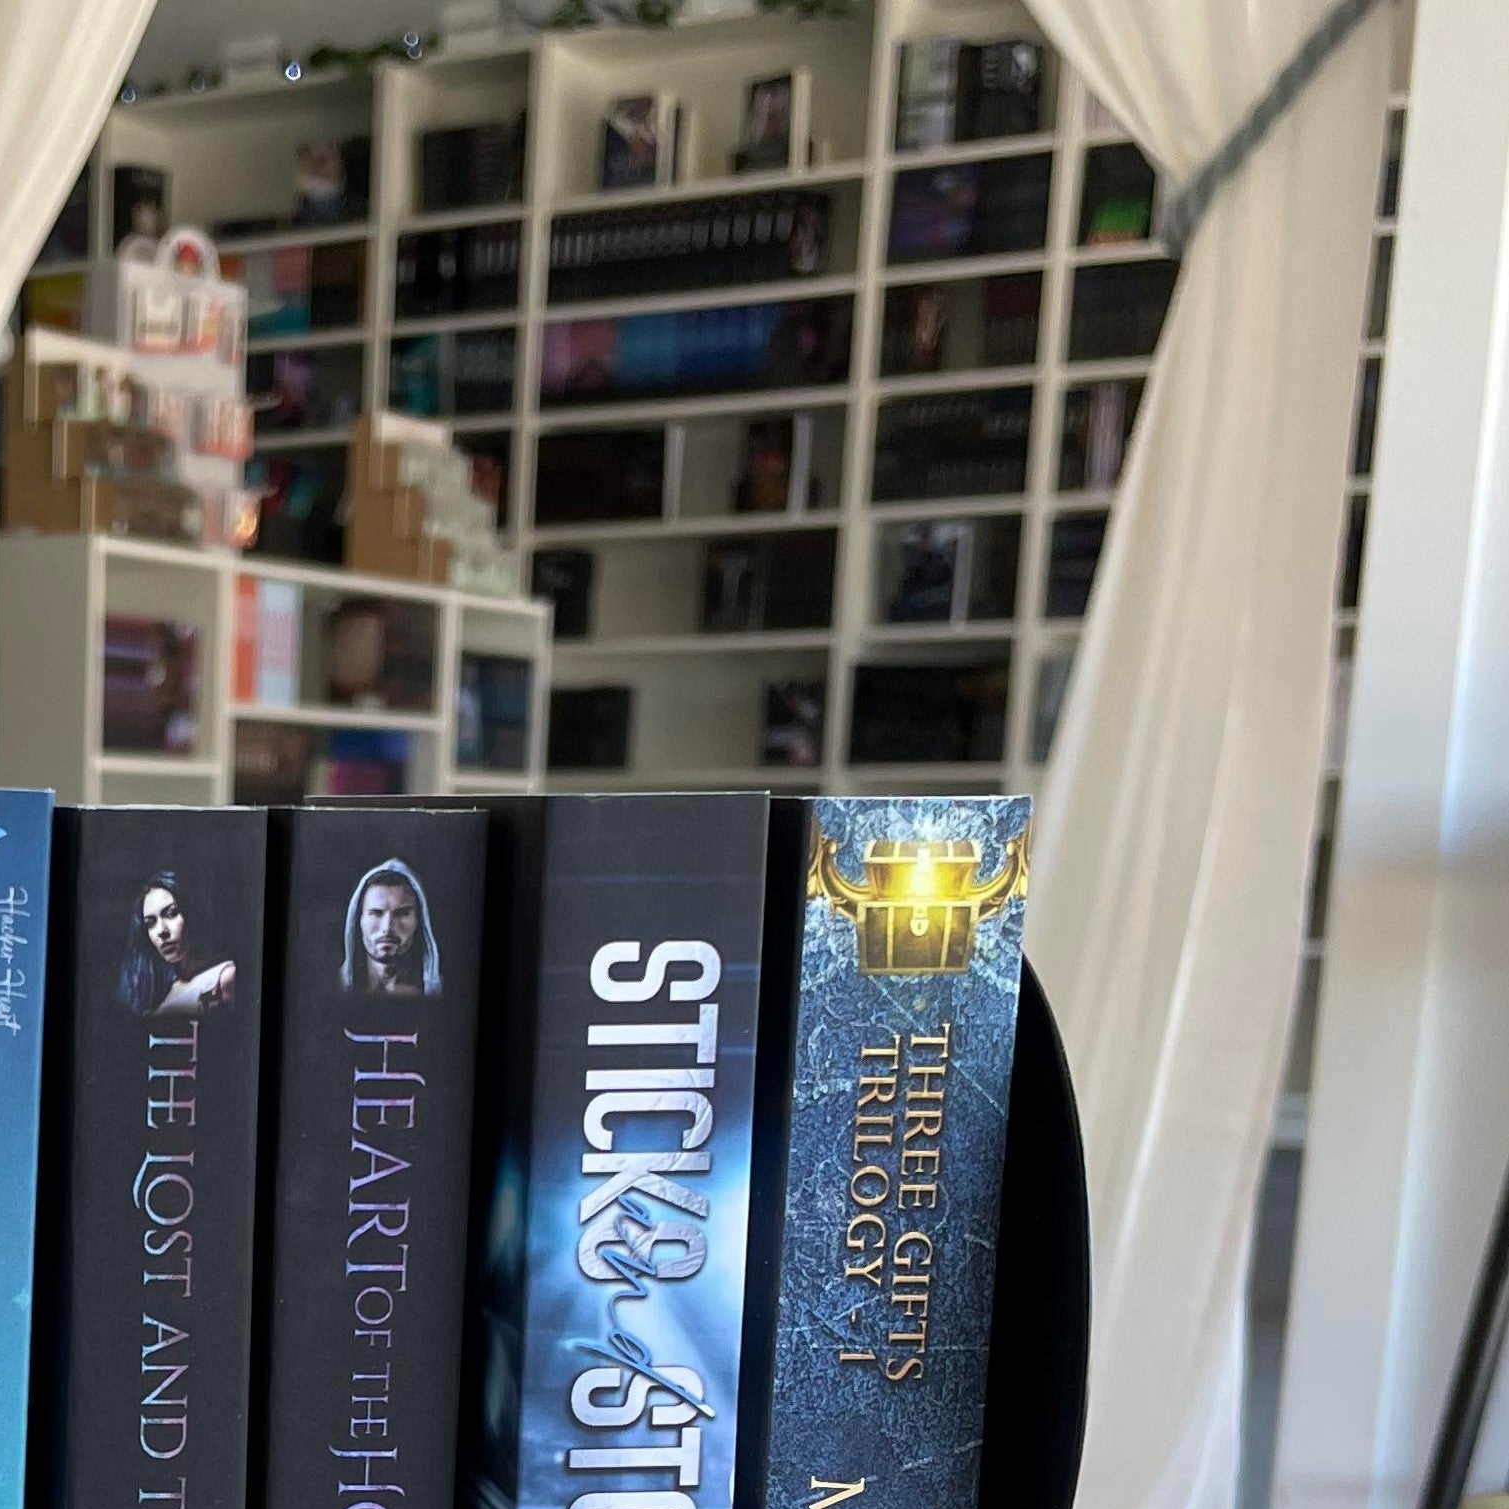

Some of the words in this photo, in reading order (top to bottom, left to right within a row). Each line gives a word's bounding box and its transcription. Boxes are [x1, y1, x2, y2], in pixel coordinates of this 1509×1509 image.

[146, 1020, 199, 1130] THE
[898, 1023, 952, 1211] THREE
[132, 1150, 194, 1298] LOST
[343, 1027, 426, 1292] HEART
[844, 1034, 901, 1288] TRILOGY
[351, 1285, 394, 1348] OF
[886, 1231, 935, 1382] GIFTS
[138, 1312, 191, 1459] AND
[349, 1362, 392, 1439] THE
